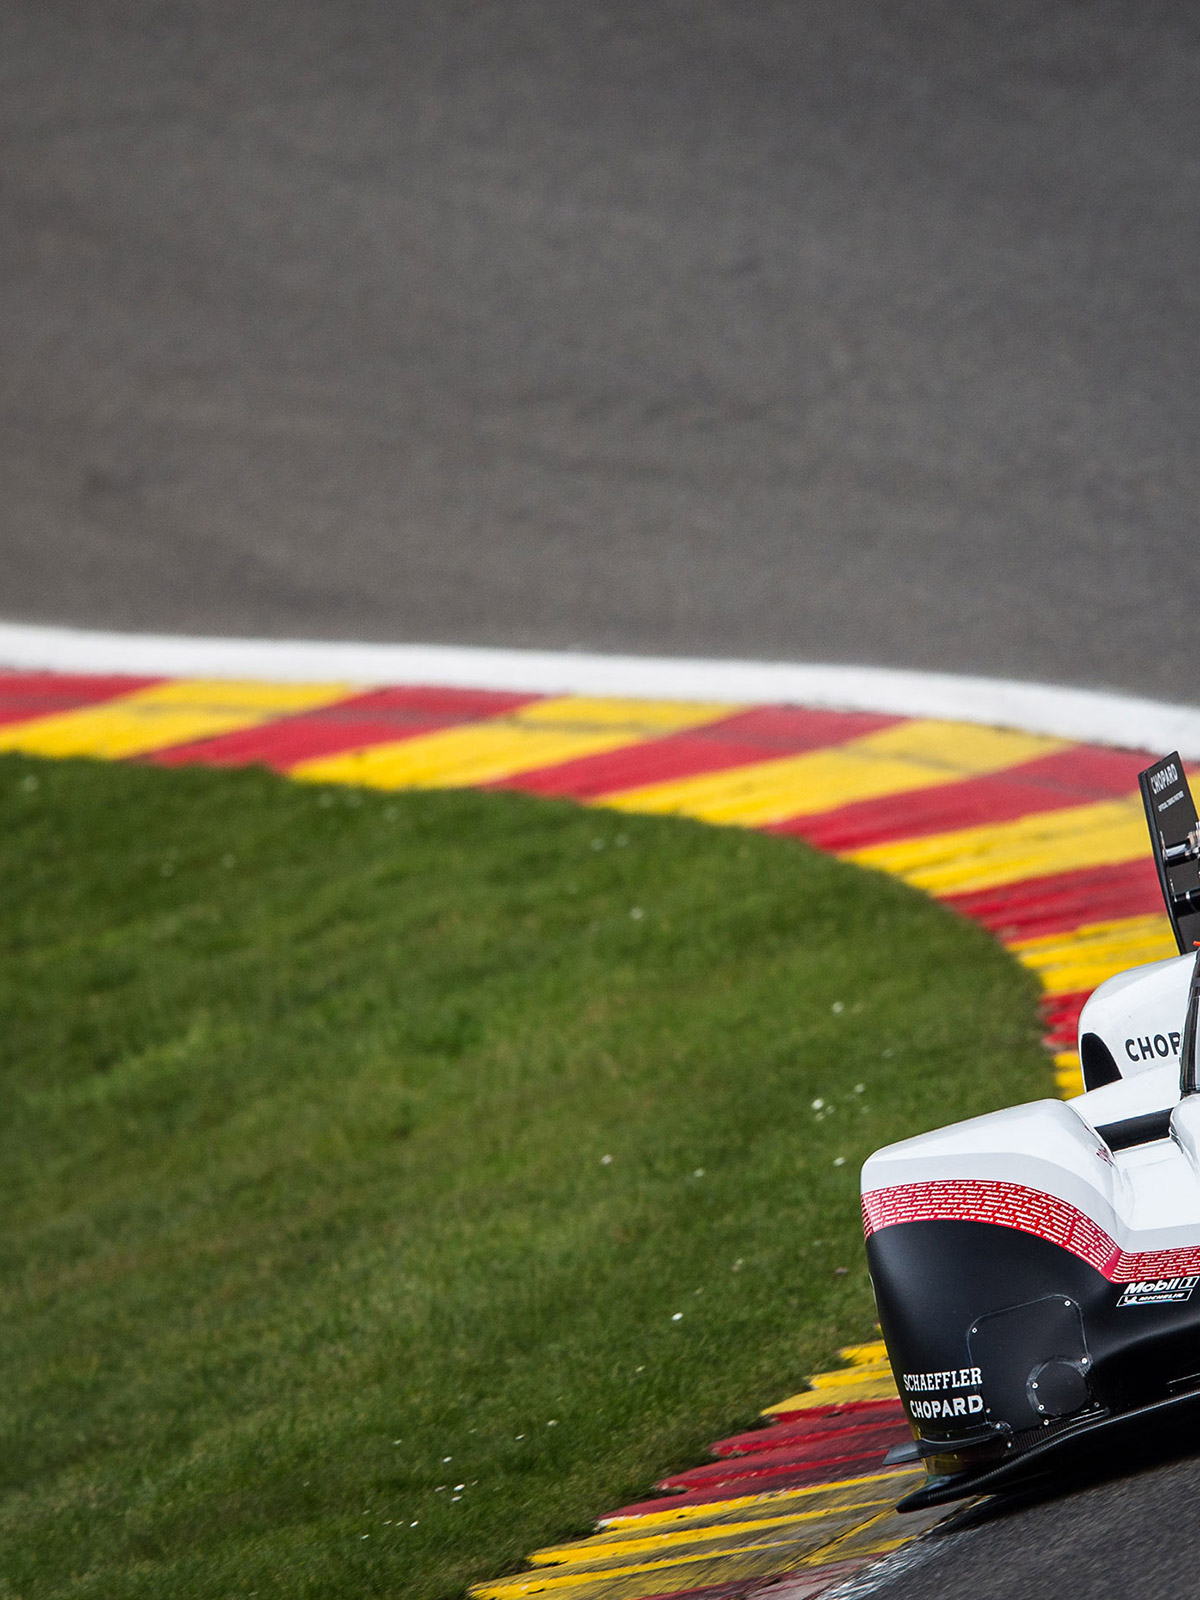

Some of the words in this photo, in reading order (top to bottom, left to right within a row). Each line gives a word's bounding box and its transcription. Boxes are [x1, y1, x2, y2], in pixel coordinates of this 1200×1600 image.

[1150, 763, 1179, 795] CHOPARD
[1124, 1278, 1180, 1295] Mobil
[1138, 1292, 1185, 1302] MICHELIN
[903, 1367, 983, 1392] SCHAEFFLER
[910, 1394, 984, 1419] CHOPARD
